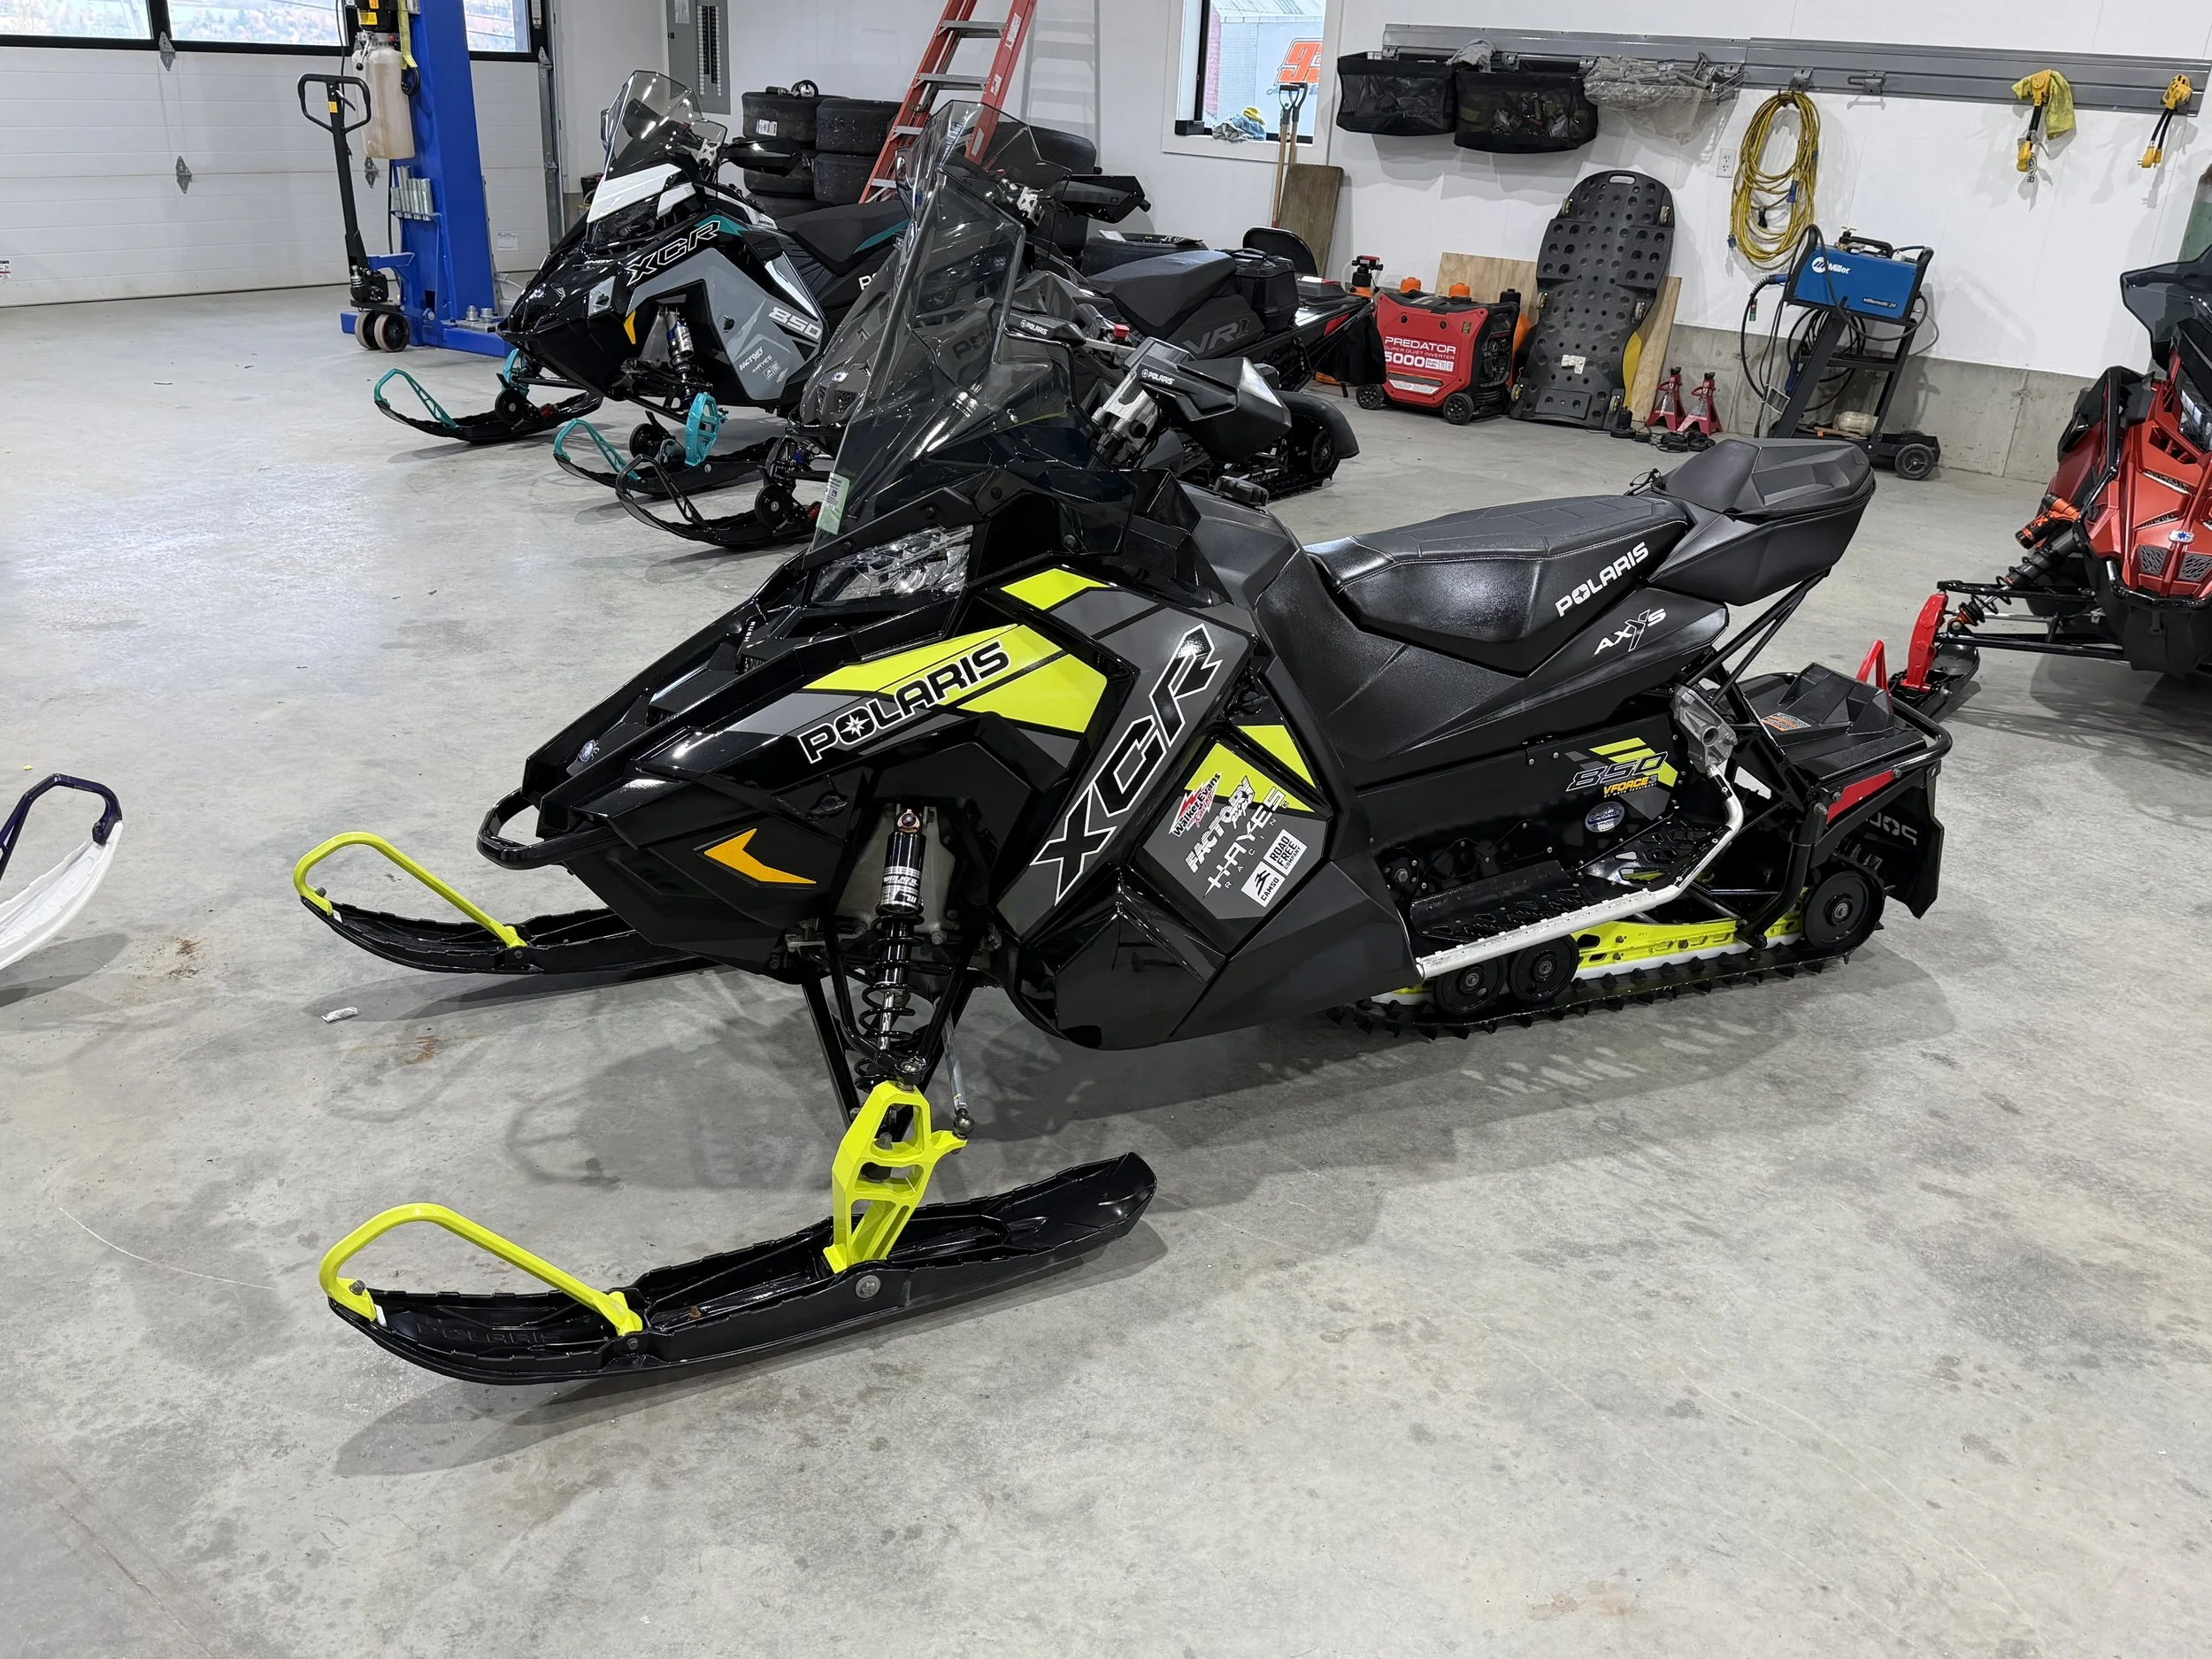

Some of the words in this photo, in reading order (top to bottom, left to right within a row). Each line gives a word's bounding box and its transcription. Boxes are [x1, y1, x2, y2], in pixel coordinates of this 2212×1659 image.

[625, 220, 720, 287] XCR
[1828, 263, 1851, 274] Miller
[768, 306, 822, 340] 850
[1025, 322, 1048, 335] POLARIS
[1384, 336, 1456, 355] PREDATOR
[1384, 350, 1425, 368] 5000
[1425, 351, 1455, 360] INVERTER
[1148, 371, 1176, 385] POLARIS
[1555, 541, 1649, 618] POLARIS
[1593, 608, 1667, 653] AXYS
[797, 640, 1010, 764] POLARIS
[1029, 623, 1224, 907] XCR
[1565, 750, 1669, 792] 850
[1172, 801, 1202, 837] Walker
[1198, 772, 1221, 804] Evans
[1185, 774, 1256, 874] FACTORY
[1202, 786, 1286, 899] HAYES
[1269, 835, 1290, 861] ROAD
[1276, 841, 1297, 867] FREE
[1283, 847, 1302, 870] COMPANY
[1260, 877, 1279, 902] CAMSO
